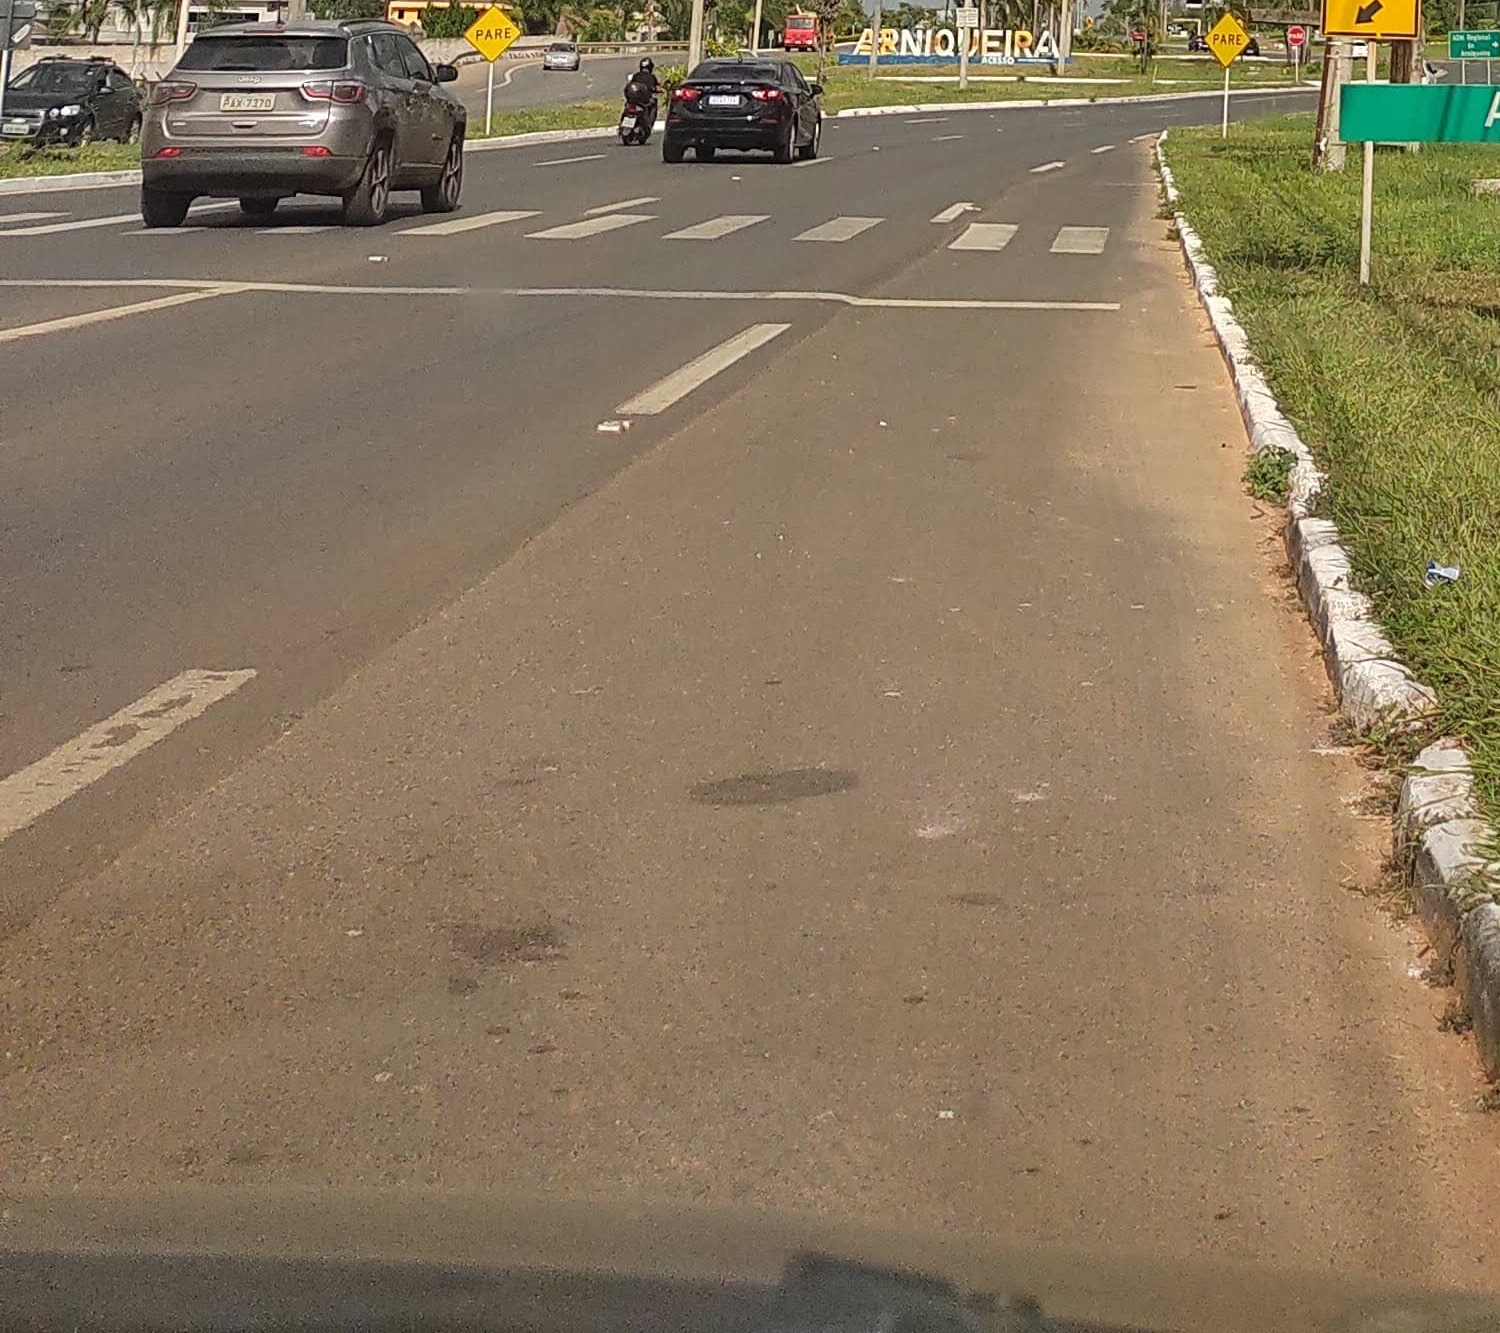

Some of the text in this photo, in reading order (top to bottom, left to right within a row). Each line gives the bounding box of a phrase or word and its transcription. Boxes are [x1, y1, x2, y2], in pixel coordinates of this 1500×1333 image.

[475, 28, 512, 41] PARE
[1212, 33, 1243, 46] PARE
[1466, 34, 1491, 42] Regional
[853, 28, 1060, 58] ARNIQUEIRA
[981, 56, 1015, 65] ACESSO
